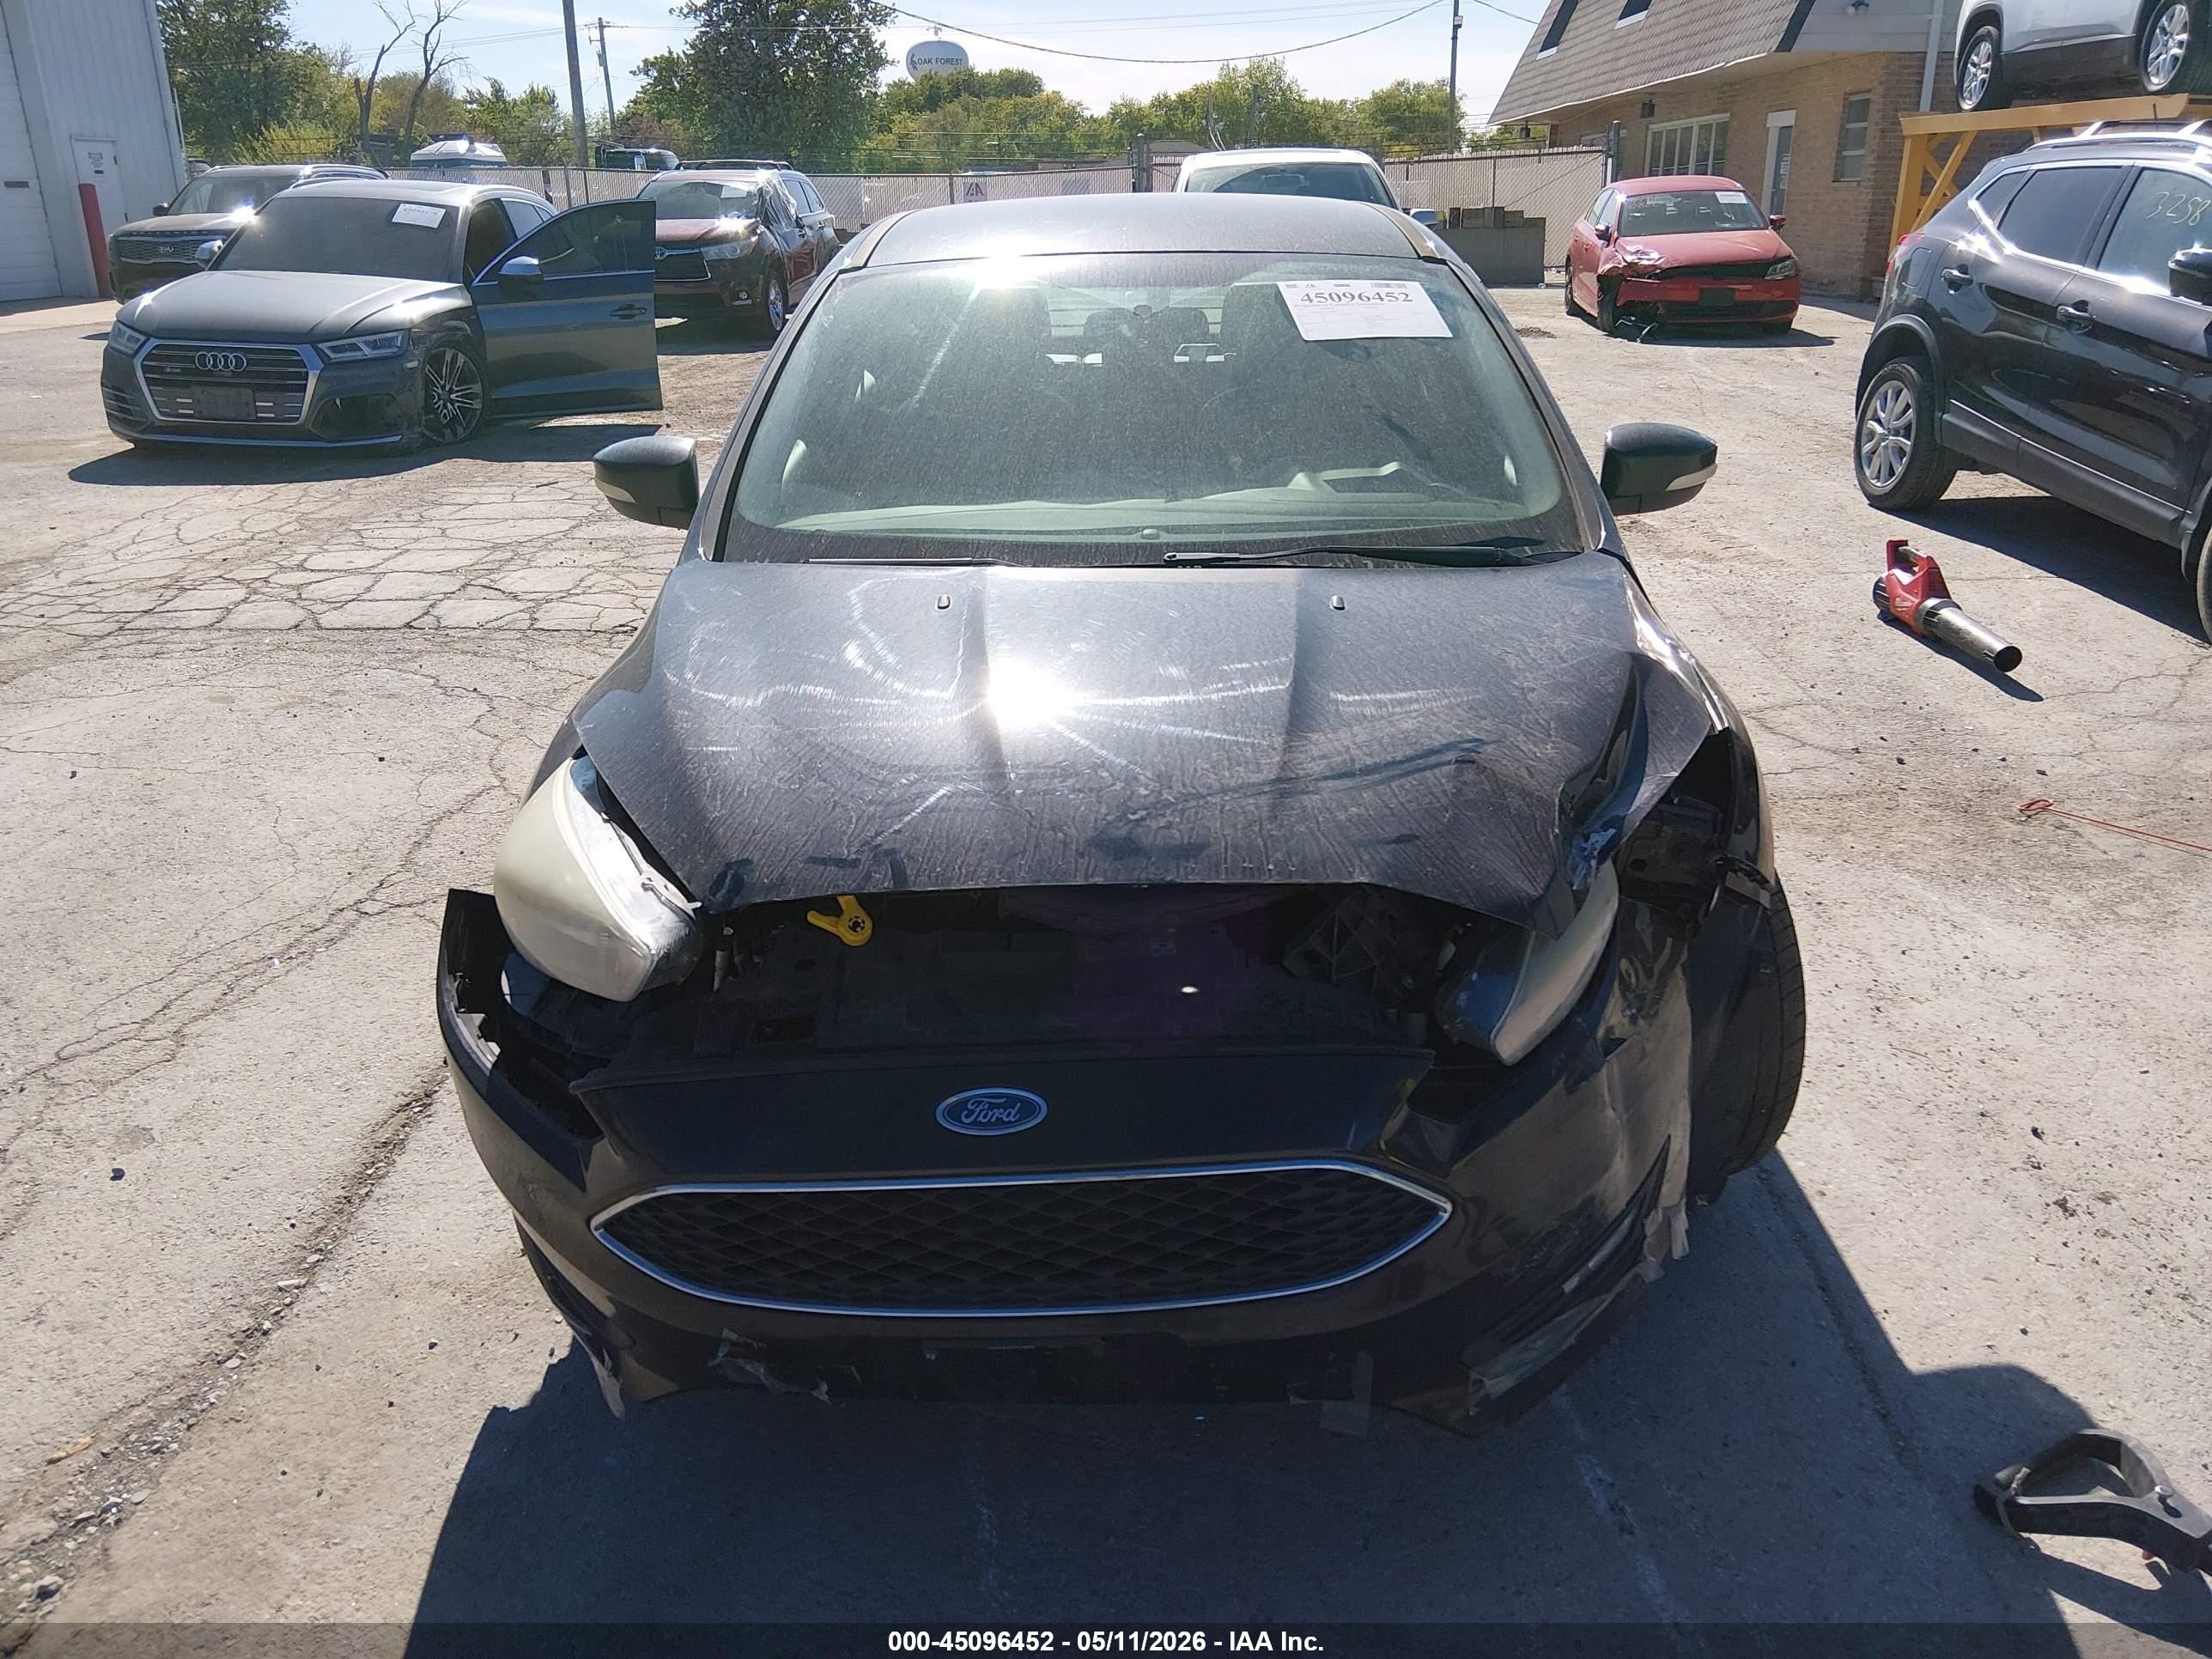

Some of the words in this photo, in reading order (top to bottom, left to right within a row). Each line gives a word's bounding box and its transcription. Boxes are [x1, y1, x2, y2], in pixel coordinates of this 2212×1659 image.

[917, 58, 933, 66] OAK
[935, 58, 963, 66] FOREST
[2146, 191, 2211, 226] 3258
[1300, 291, 1413, 304] 45096452
[961, 1097, 1022, 1124] Ford
